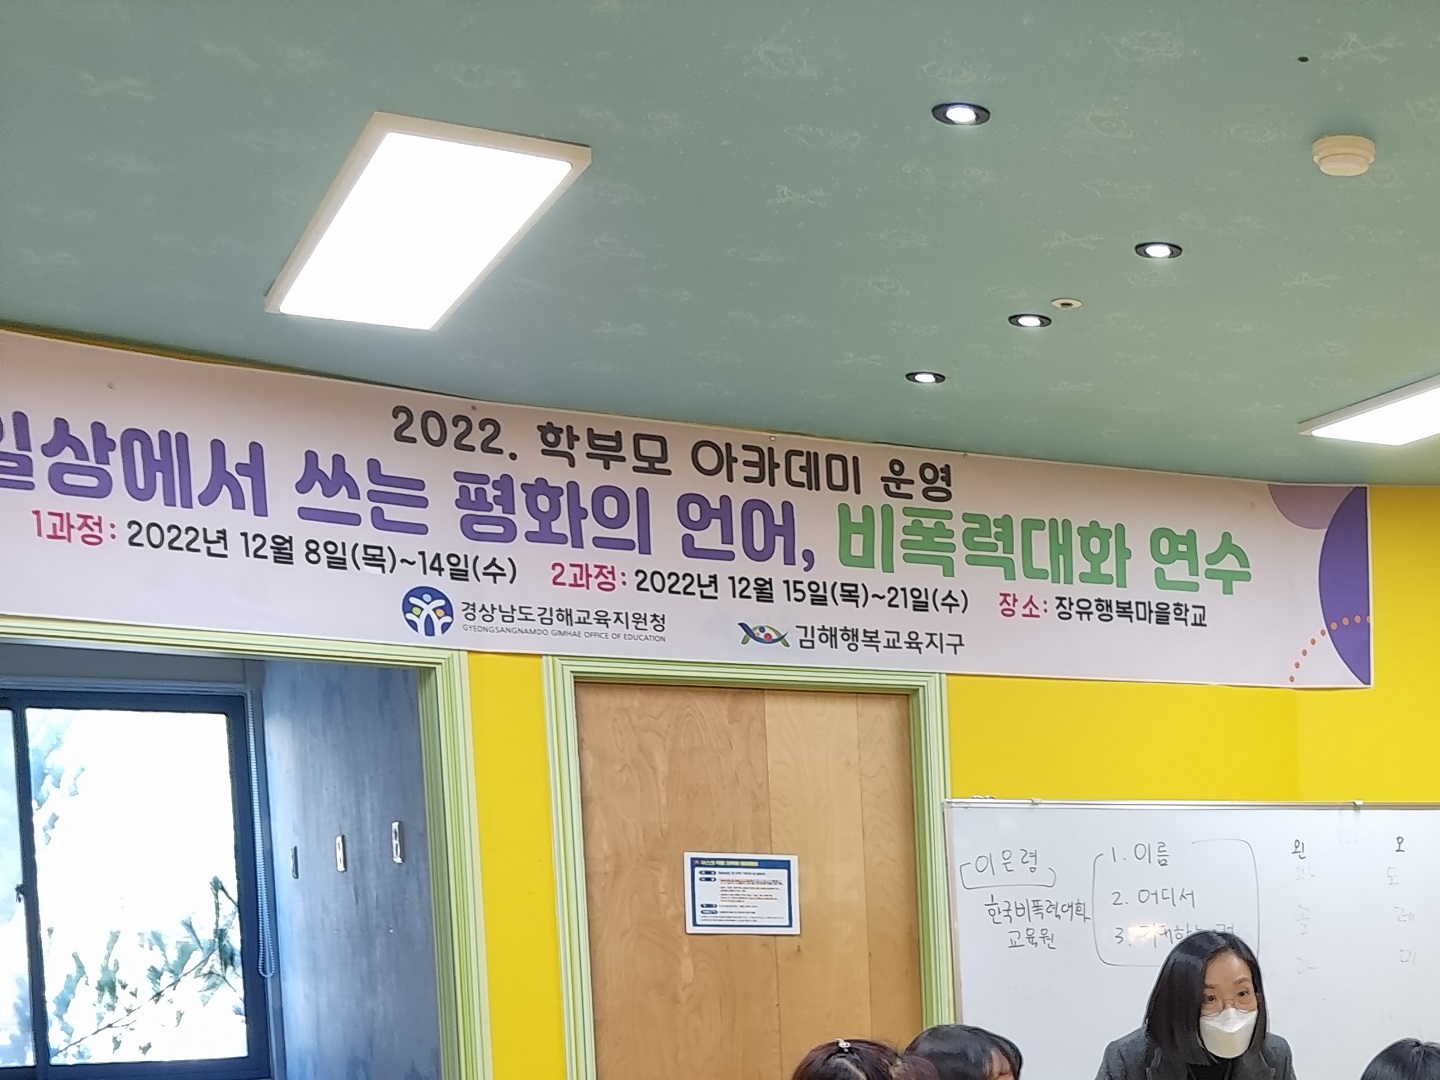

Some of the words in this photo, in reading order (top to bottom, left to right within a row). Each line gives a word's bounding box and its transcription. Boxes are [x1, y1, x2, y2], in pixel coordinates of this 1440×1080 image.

[391, 405, 517, 461] 2022.
[538, 421, 670, 475] 학부모
[691, 440, 861, 495] 아카데미
[880, 457, 953, 502] 운영
[296, 446, 429, 537] 쓰는
[453, 470, 652, 556] 평화의
[678, 490, 815, 573] 언어,
[837, 502, 1131, 590] 비폭력대화
[1150, 526, 1252, 596] 연수
[32, 510, 117, 546] 1과정:
[127, 520, 228, 558] 2022년
[239, 532, 295, 566] 12월
[305, 537, 517, 587] 8일(목)~14일(수)
[551, 563, 628, 593] 2과정:
[634, 567, 719, 602] 2022년
[727, 575, 775, 604] 12월
[782, 580, 969, 616] 15일(목)~21일(수)
[999, 592, 1049, 620] 장소:
[1055, 597, 1208, 629] 장유행복마을학교
[460, 601, 667, 633] 경상남도김해교육지원청
[795, 624, 966, 656] 김해행복교육지구
[1111, 846, 1127, 862] 1.
[1134, 841, 1170, 867] 이름
[1111, 891, 1129, 907] 2.
[1138, 887, 1197, 909] 어디서
[1007, 927, 1056, 950] 교육원
